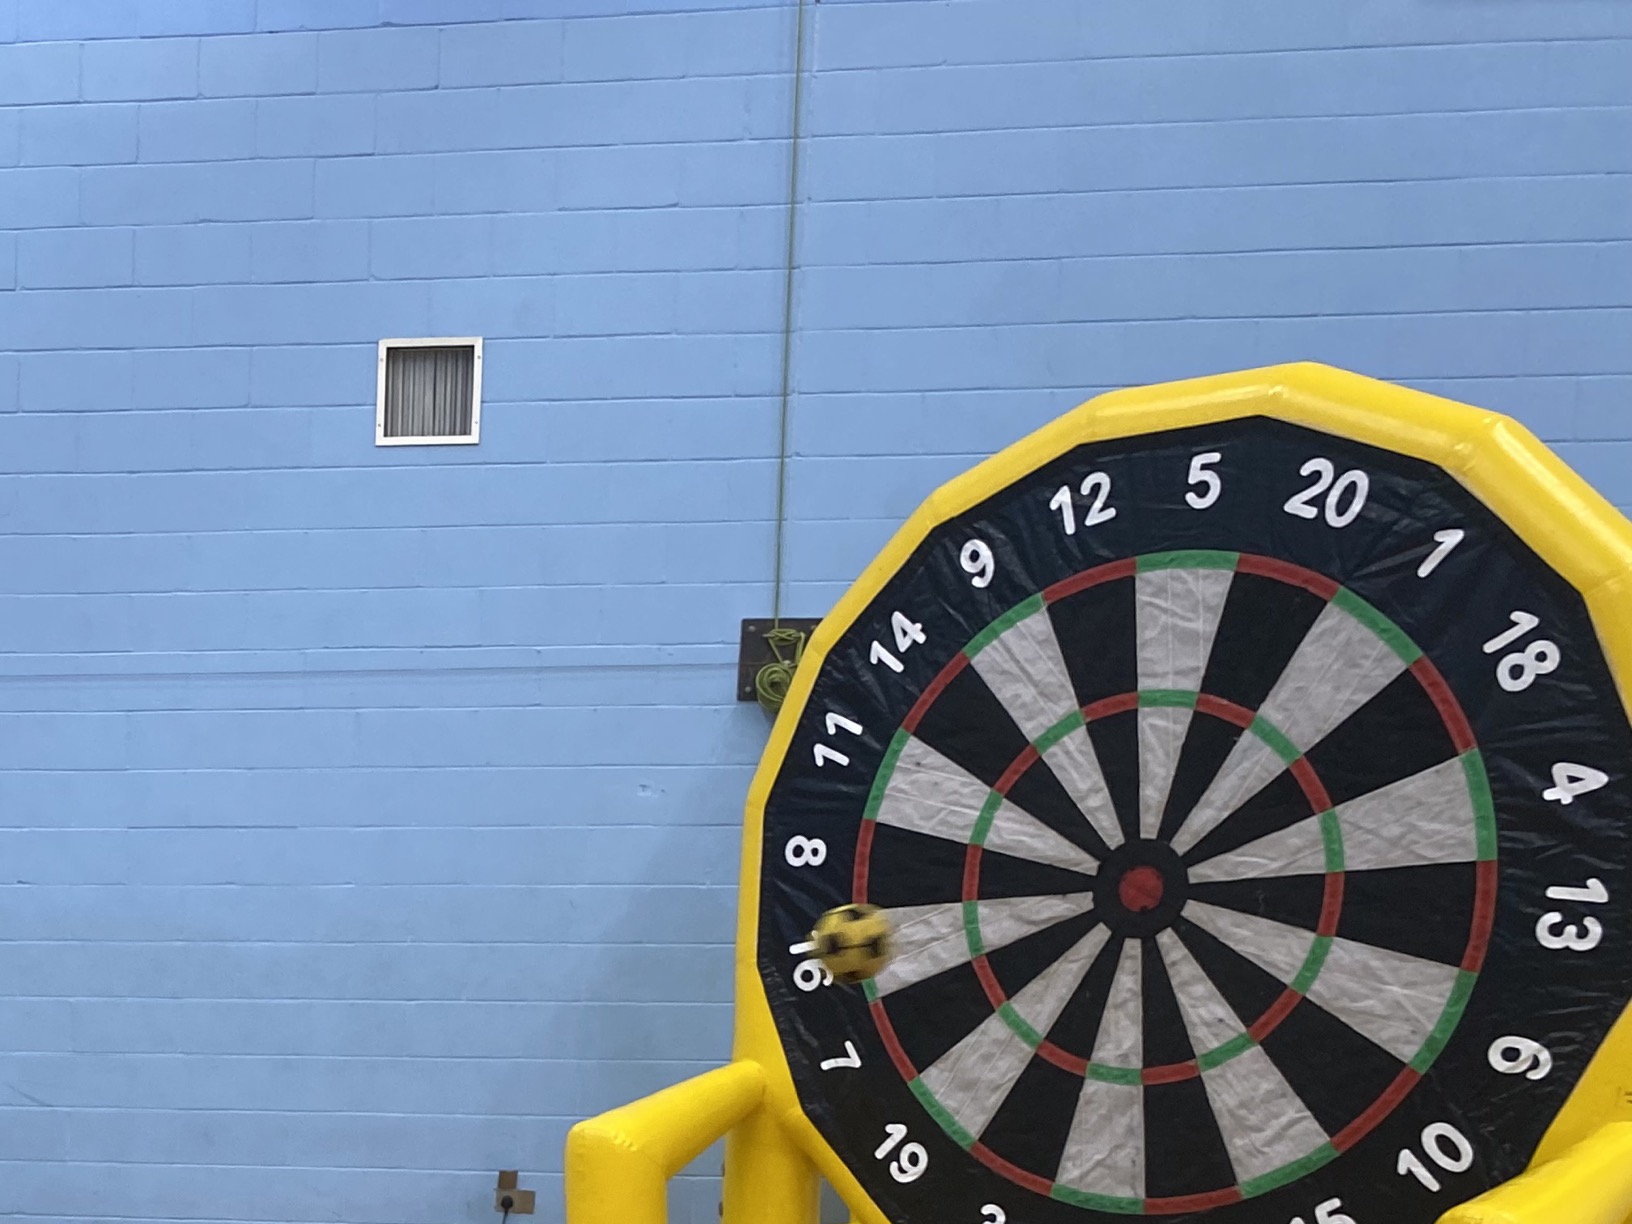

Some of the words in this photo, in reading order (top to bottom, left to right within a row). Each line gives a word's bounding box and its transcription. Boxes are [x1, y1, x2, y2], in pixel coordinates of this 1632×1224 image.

[1048, 470, 1118, 537] 12
[1183, 450, 1223, 511] 5
[1282, 456, 1371, 529] 20
[958, 537, 996, 590] 9
[1416, 527, 1466, 579] 1
[868, 609, 928, 674] 14
[1481, 609, 1562, 693] 18
[812, 711, 864, 768] 11
[1541, 761, 1611, 806] 4
[783, 833, 828, 868] 8
[1534, 876, 1610, 952] 13
[819, 1039, 863, 1072] 7
[1486, 1034, 1554, 1081] 6
[873, 1122, 930, 1184] 19
[1396, 1121, 1475, 1193] 10
